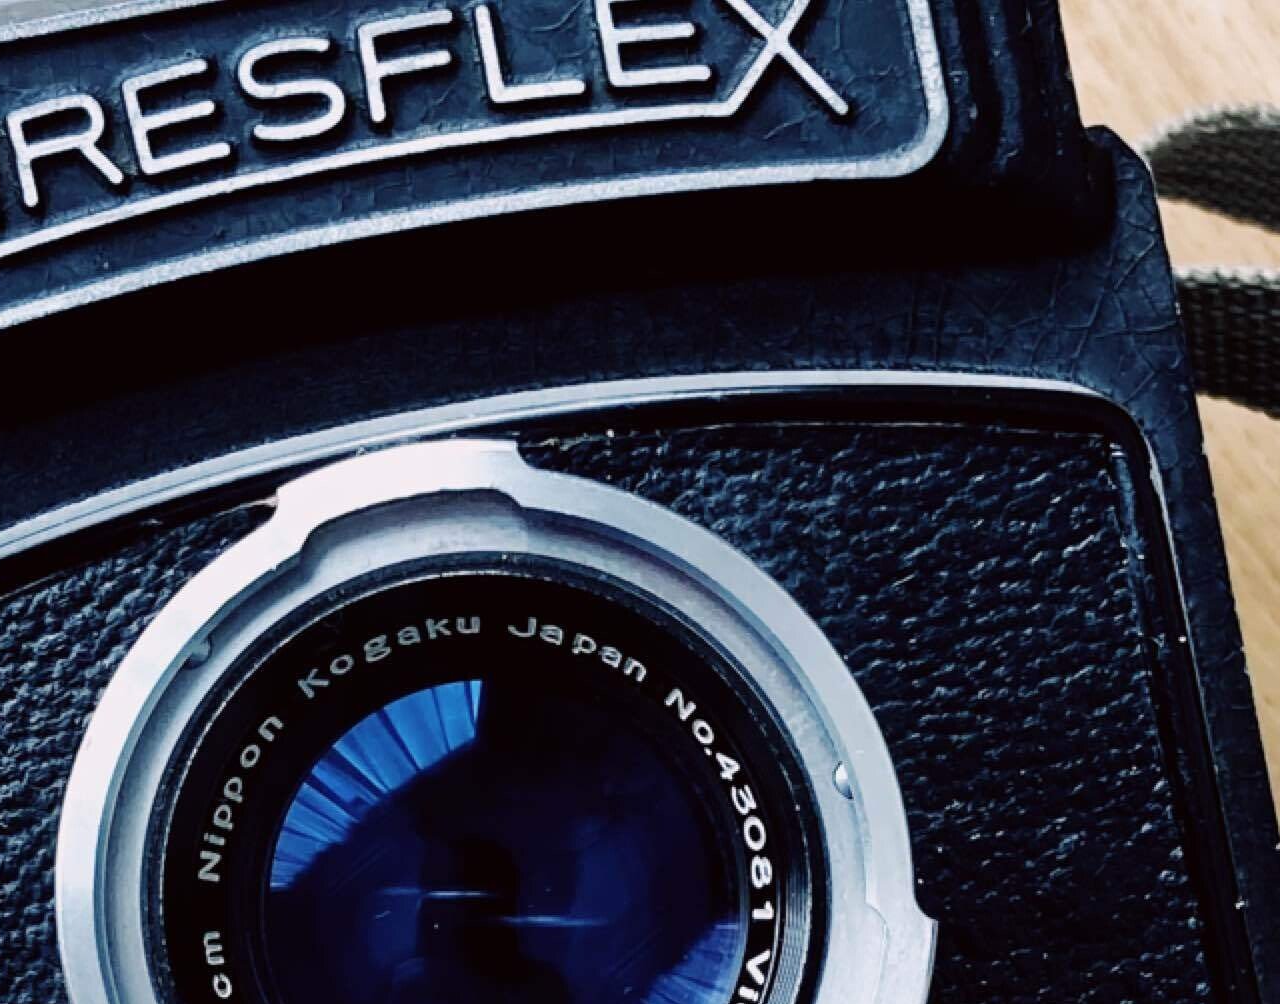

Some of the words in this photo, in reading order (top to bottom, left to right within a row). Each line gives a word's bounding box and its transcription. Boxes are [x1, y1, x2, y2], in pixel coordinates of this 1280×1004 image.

[197, 715, 285, 883] Nippon
[297, 616, 481, 699] Kogaku
[507, 616, 648, 682] Japan
[203, 930, 233, 999] cm
